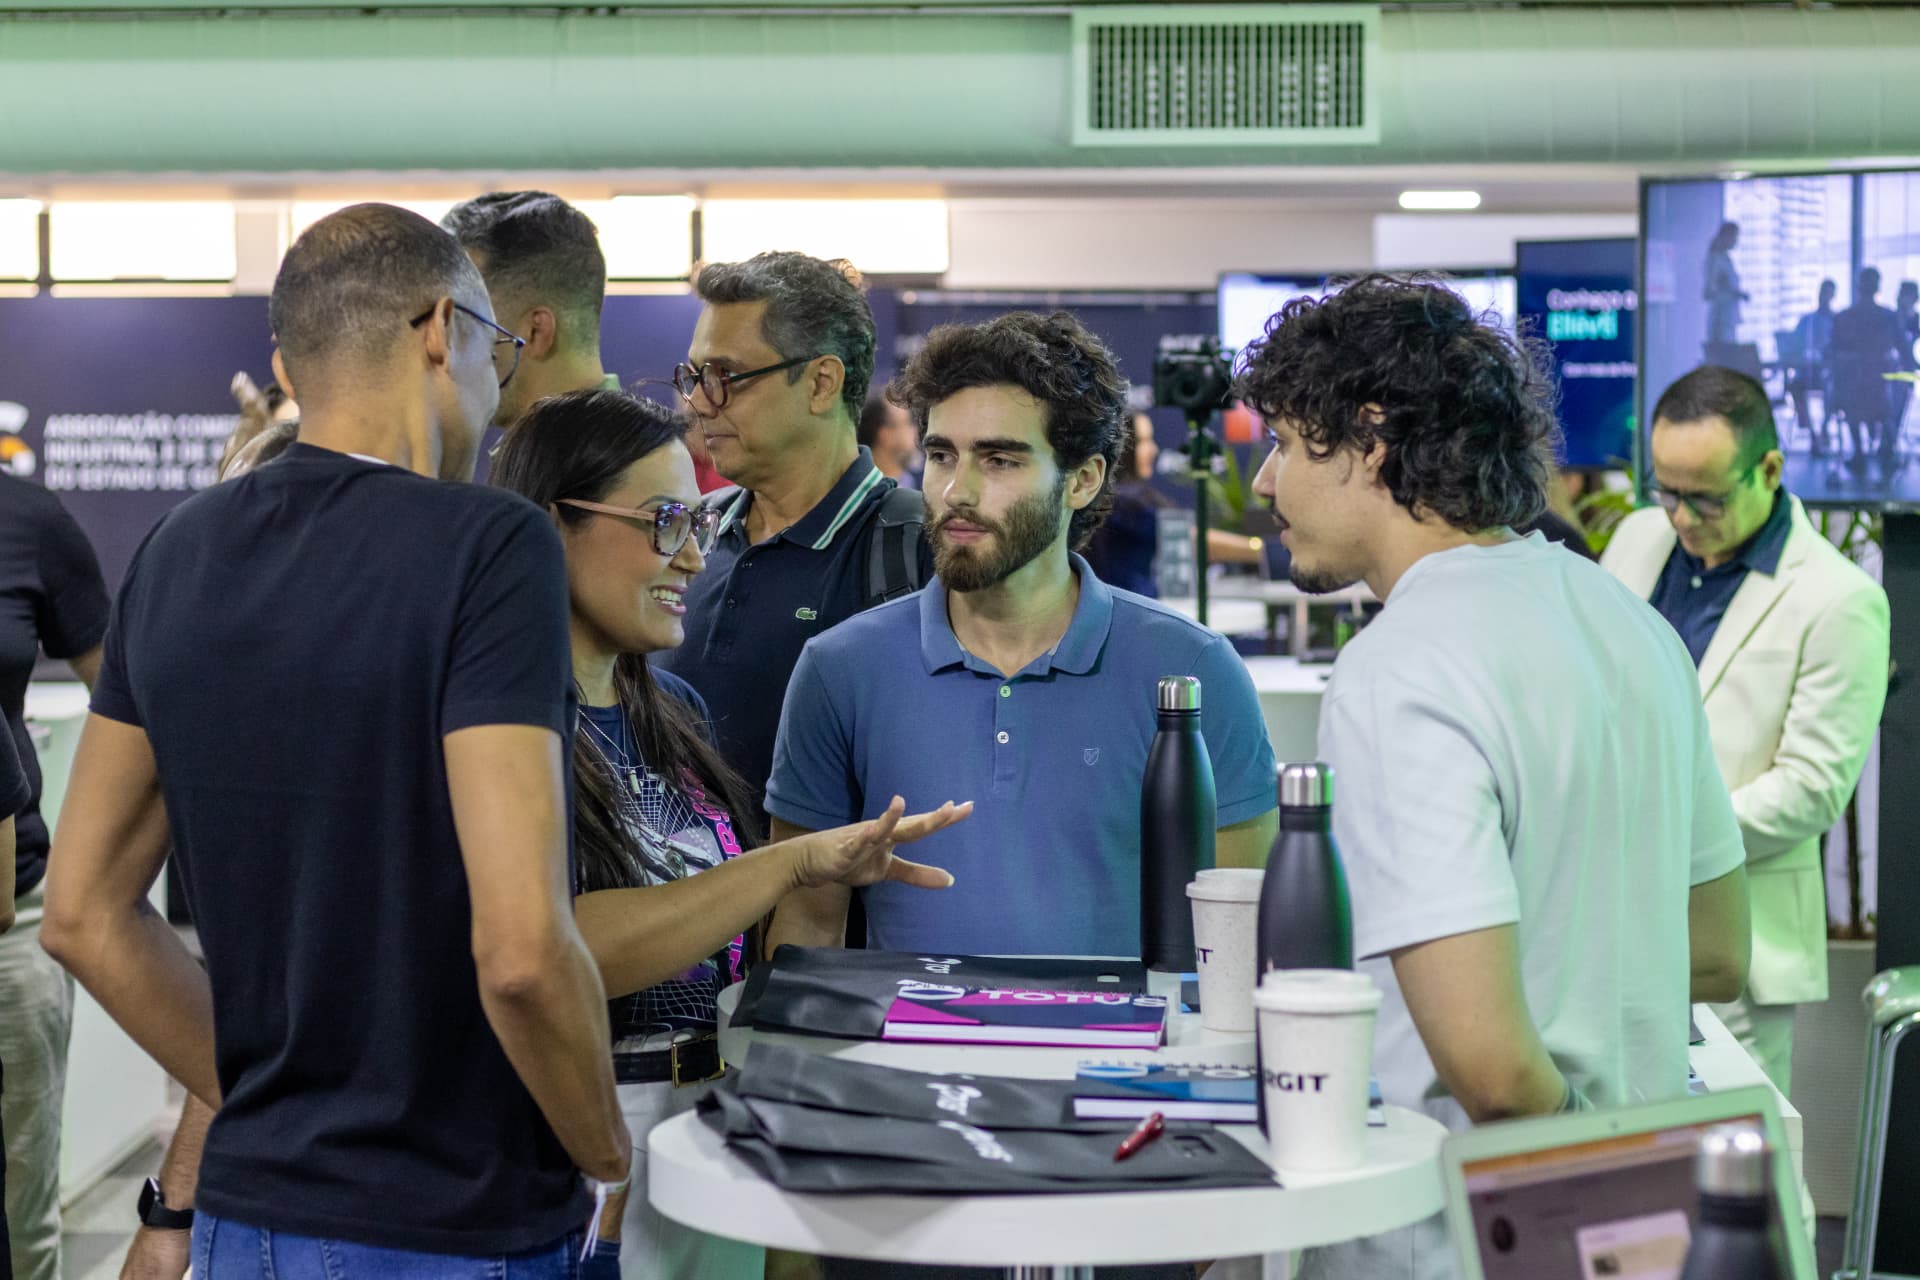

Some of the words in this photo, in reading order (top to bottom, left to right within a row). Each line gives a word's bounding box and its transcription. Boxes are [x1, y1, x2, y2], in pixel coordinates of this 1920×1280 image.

[44, 410, 173, 439] ASSOCIAÇÃO
[44, 466, 76, 490] DO
[78, 466, 156, 490] ESTADO
[159, 466, 186, 490] DE
